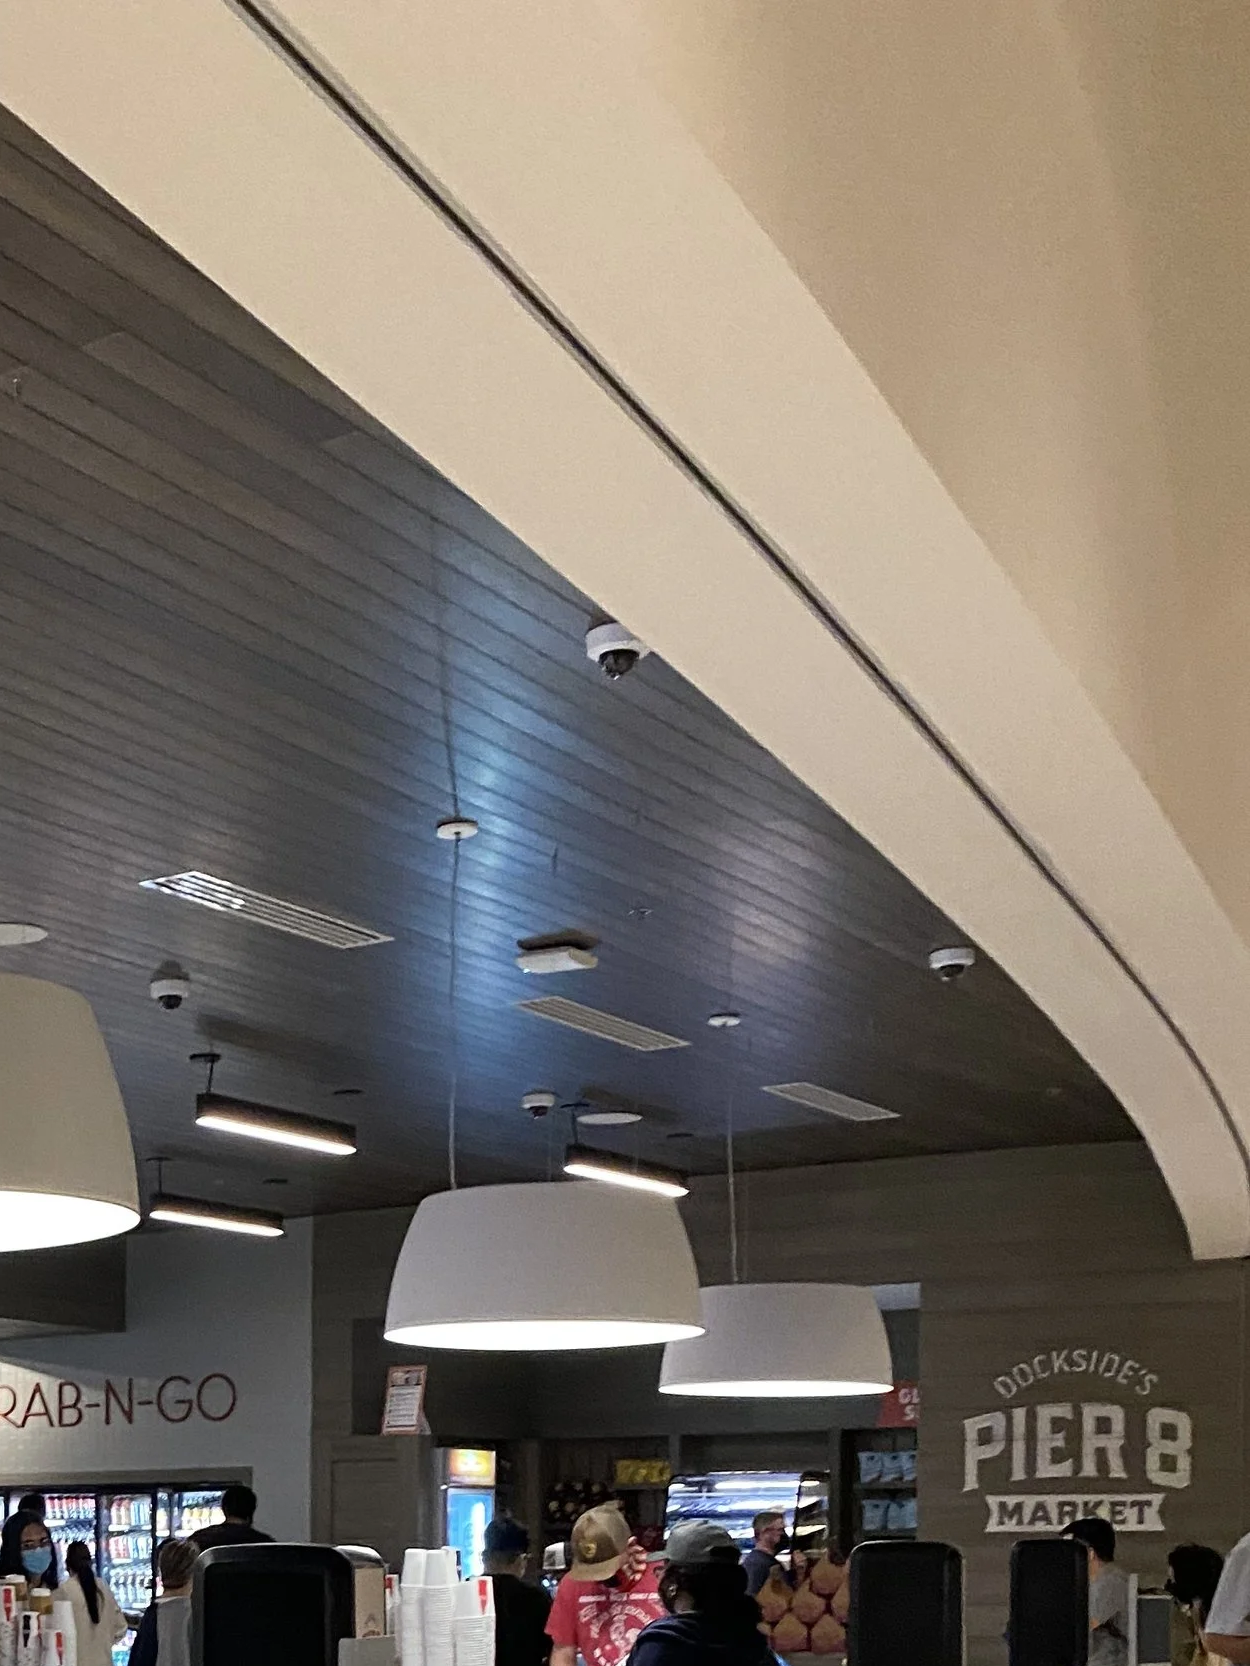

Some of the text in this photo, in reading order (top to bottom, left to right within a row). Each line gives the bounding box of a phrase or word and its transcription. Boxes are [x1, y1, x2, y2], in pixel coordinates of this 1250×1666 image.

[993, 1349, 1159, 1399] DOCKSIDE'S
[961, 1401, 1193, 1493] PIER 8
[996, 1500, 1153, 1526] MARKET
